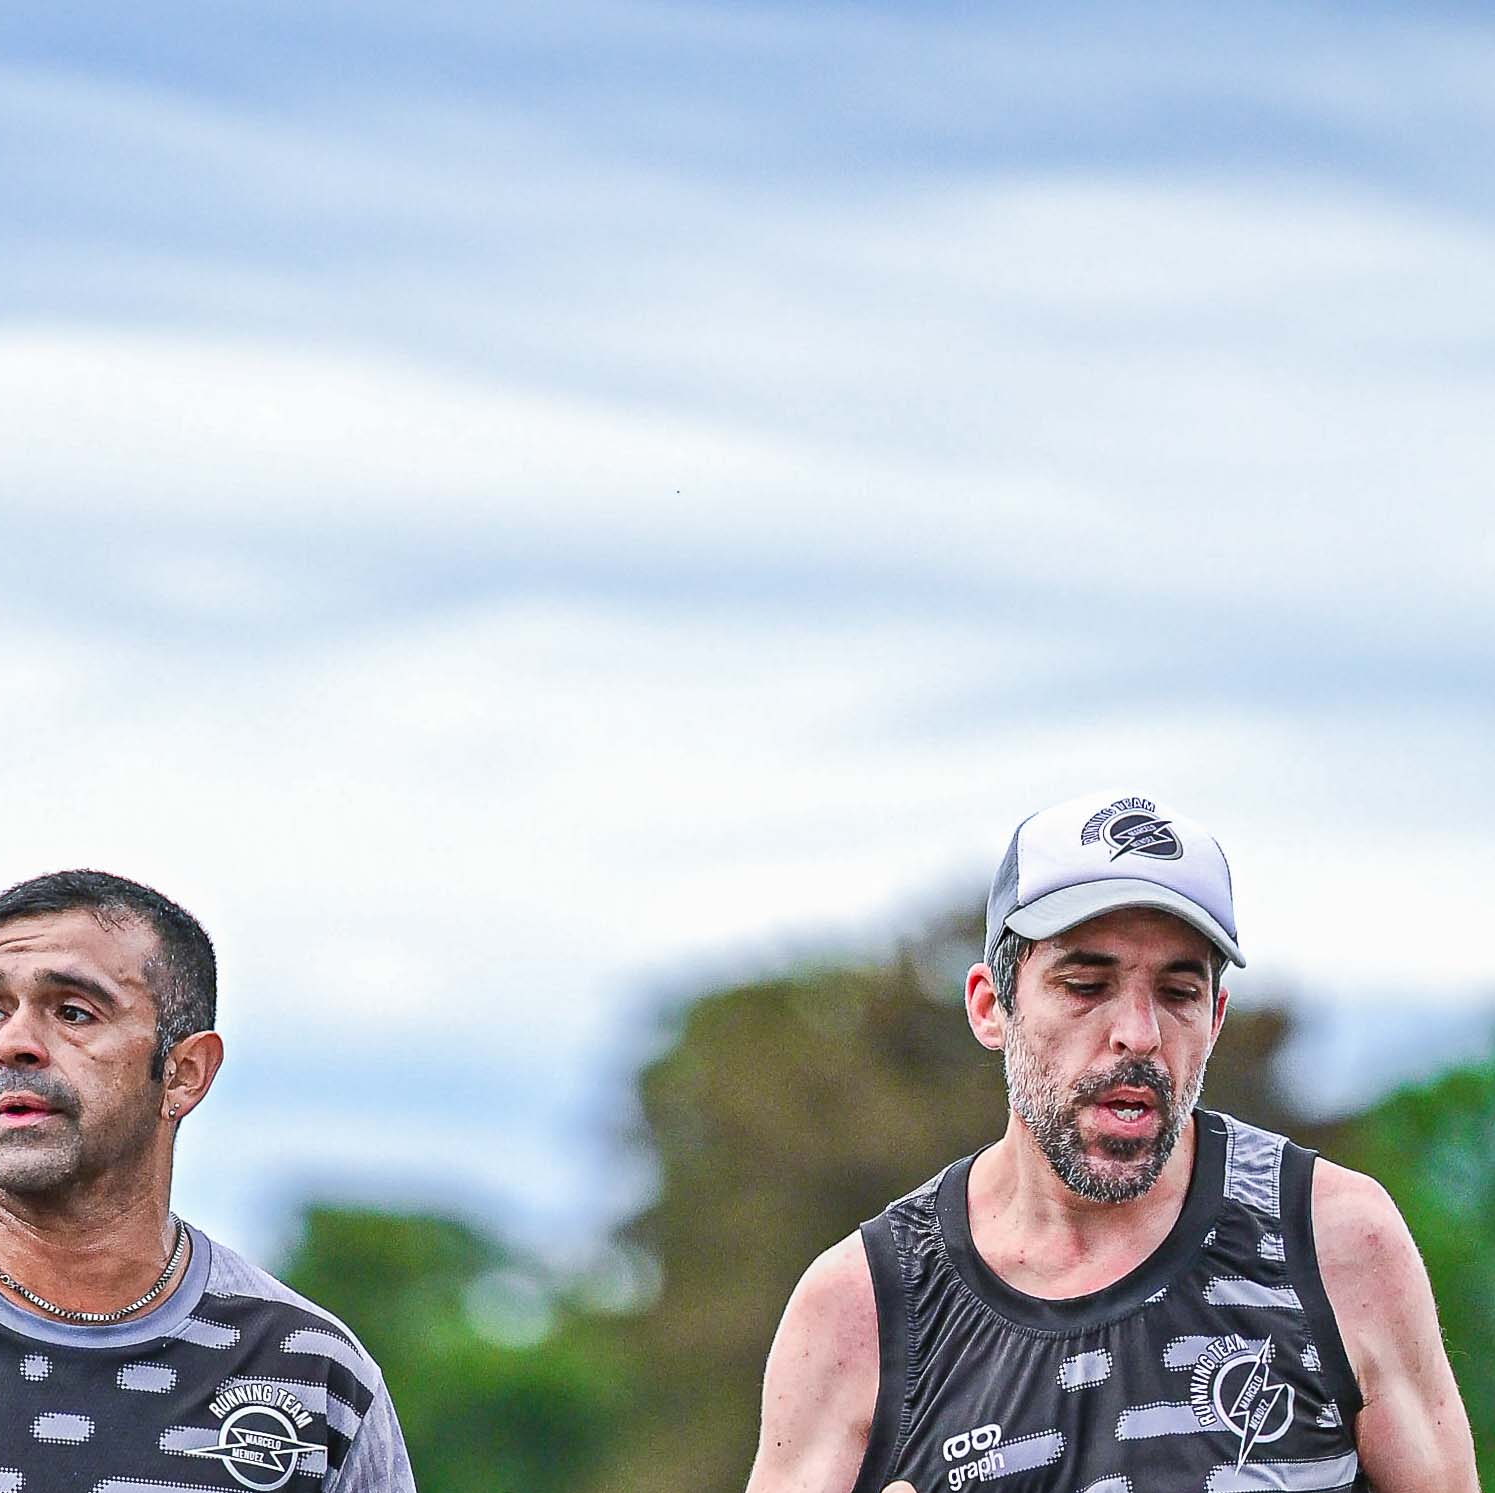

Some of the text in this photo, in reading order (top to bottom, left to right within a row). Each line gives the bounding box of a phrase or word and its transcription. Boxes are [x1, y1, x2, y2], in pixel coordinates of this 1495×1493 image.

[1189, 1333, 1249, 1427] RUNNING TEAM
[1238, 1375, 1264, 1410] MARCELO
[208, 1384, 313, 1429] RUNNING TEAM
[1248, 1398, 1271, 1431] MENDEZ
[231, 1447, 265, 1463] MENDEZ
[245, 1433, 282, 1450] MARCELO
[948, 1449, 1005, 1492] graph
